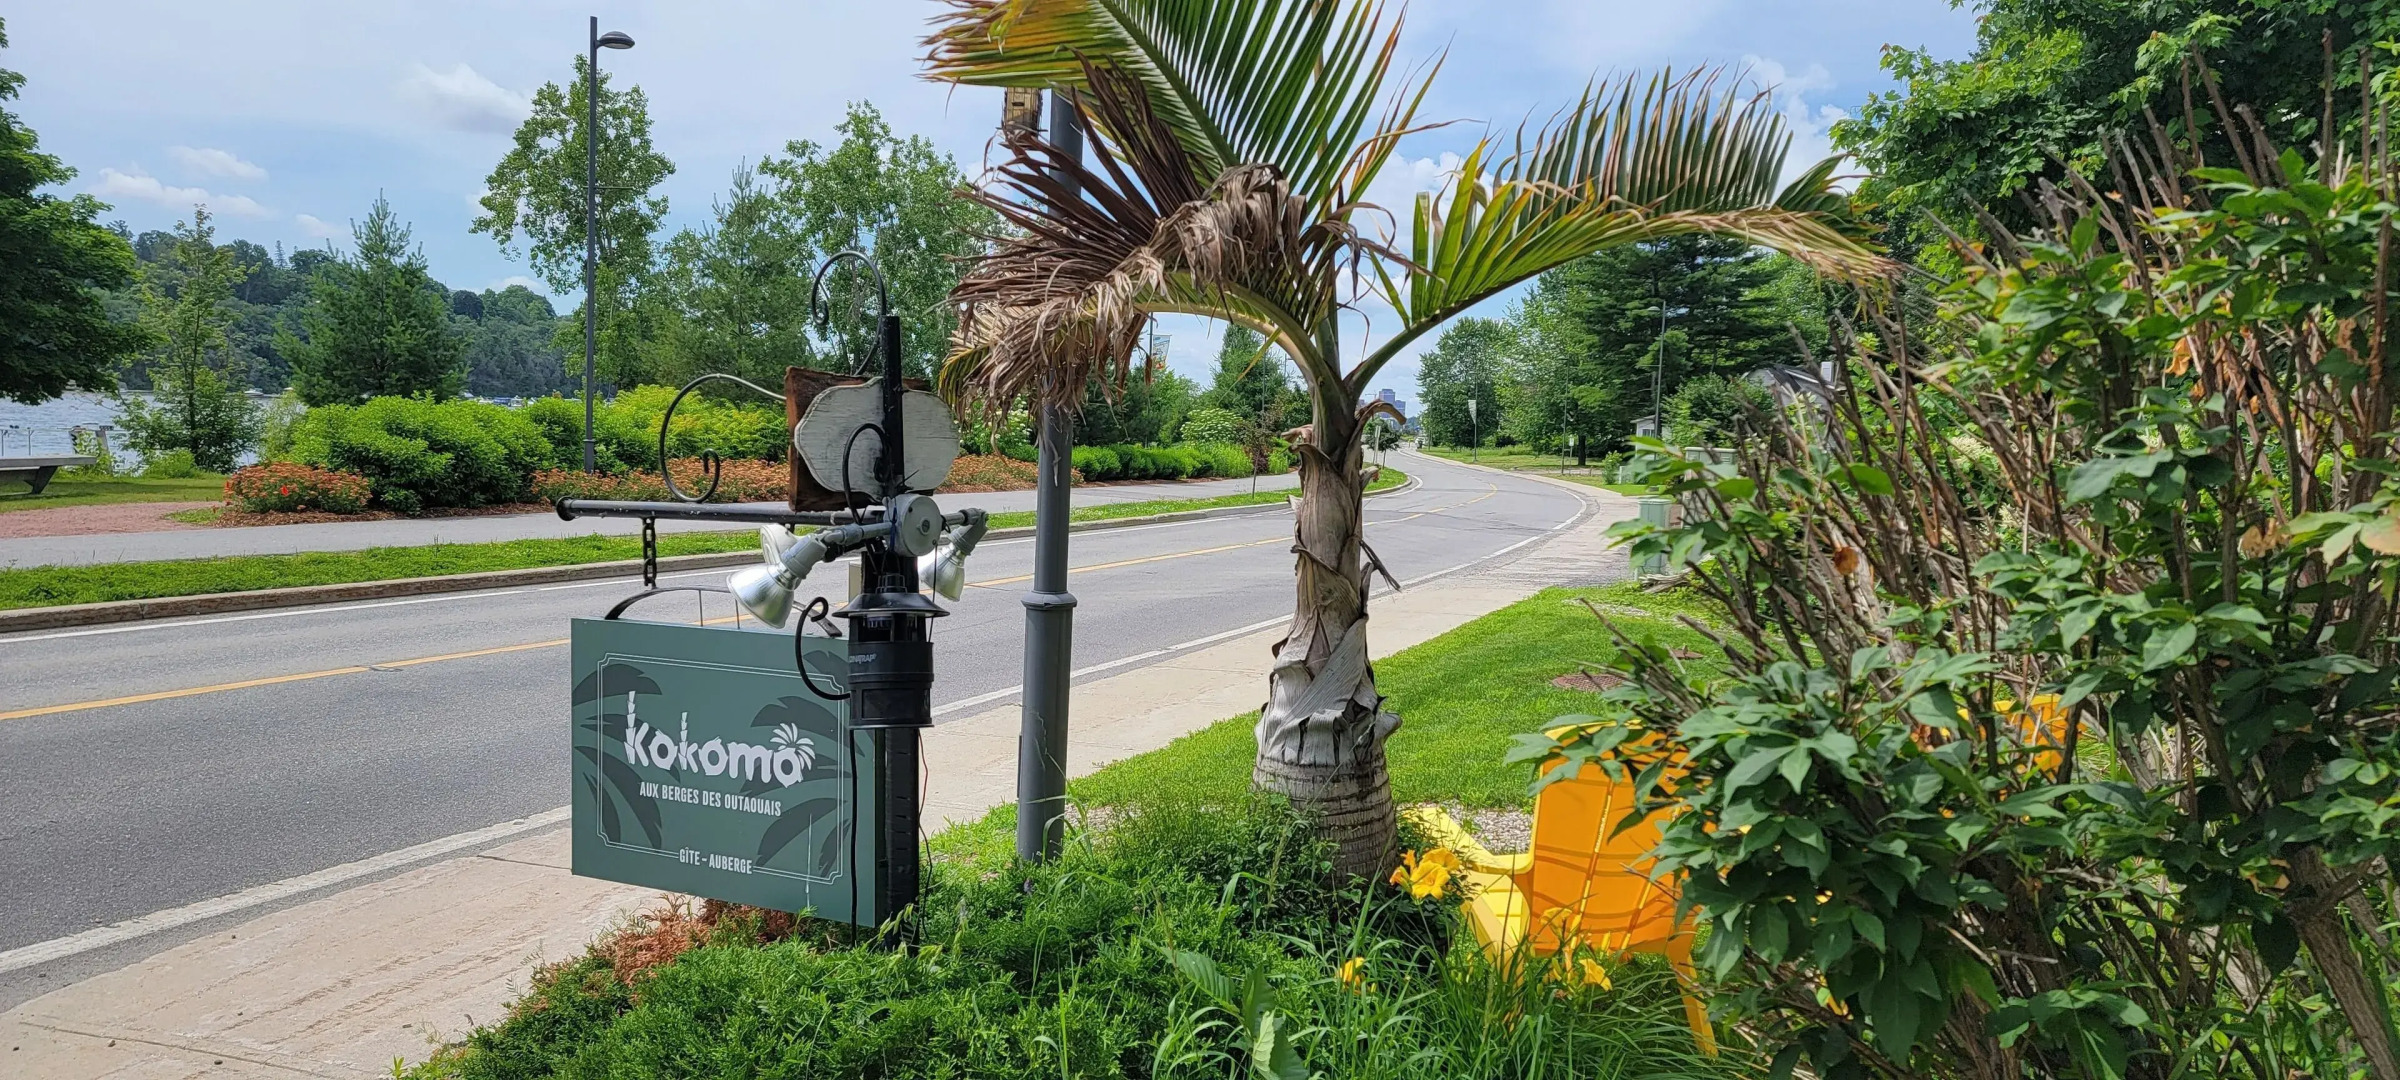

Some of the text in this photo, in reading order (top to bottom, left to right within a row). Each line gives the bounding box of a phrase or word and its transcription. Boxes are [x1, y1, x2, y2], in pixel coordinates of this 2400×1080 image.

[624, 690, 809, 788] kokomo
[639, 781, 782, 817] AUX BERGES DES OUTAOUAIS
[679, 846, 700, 866] GÎTE
[708, 853, 753, 875] AUBERGE
